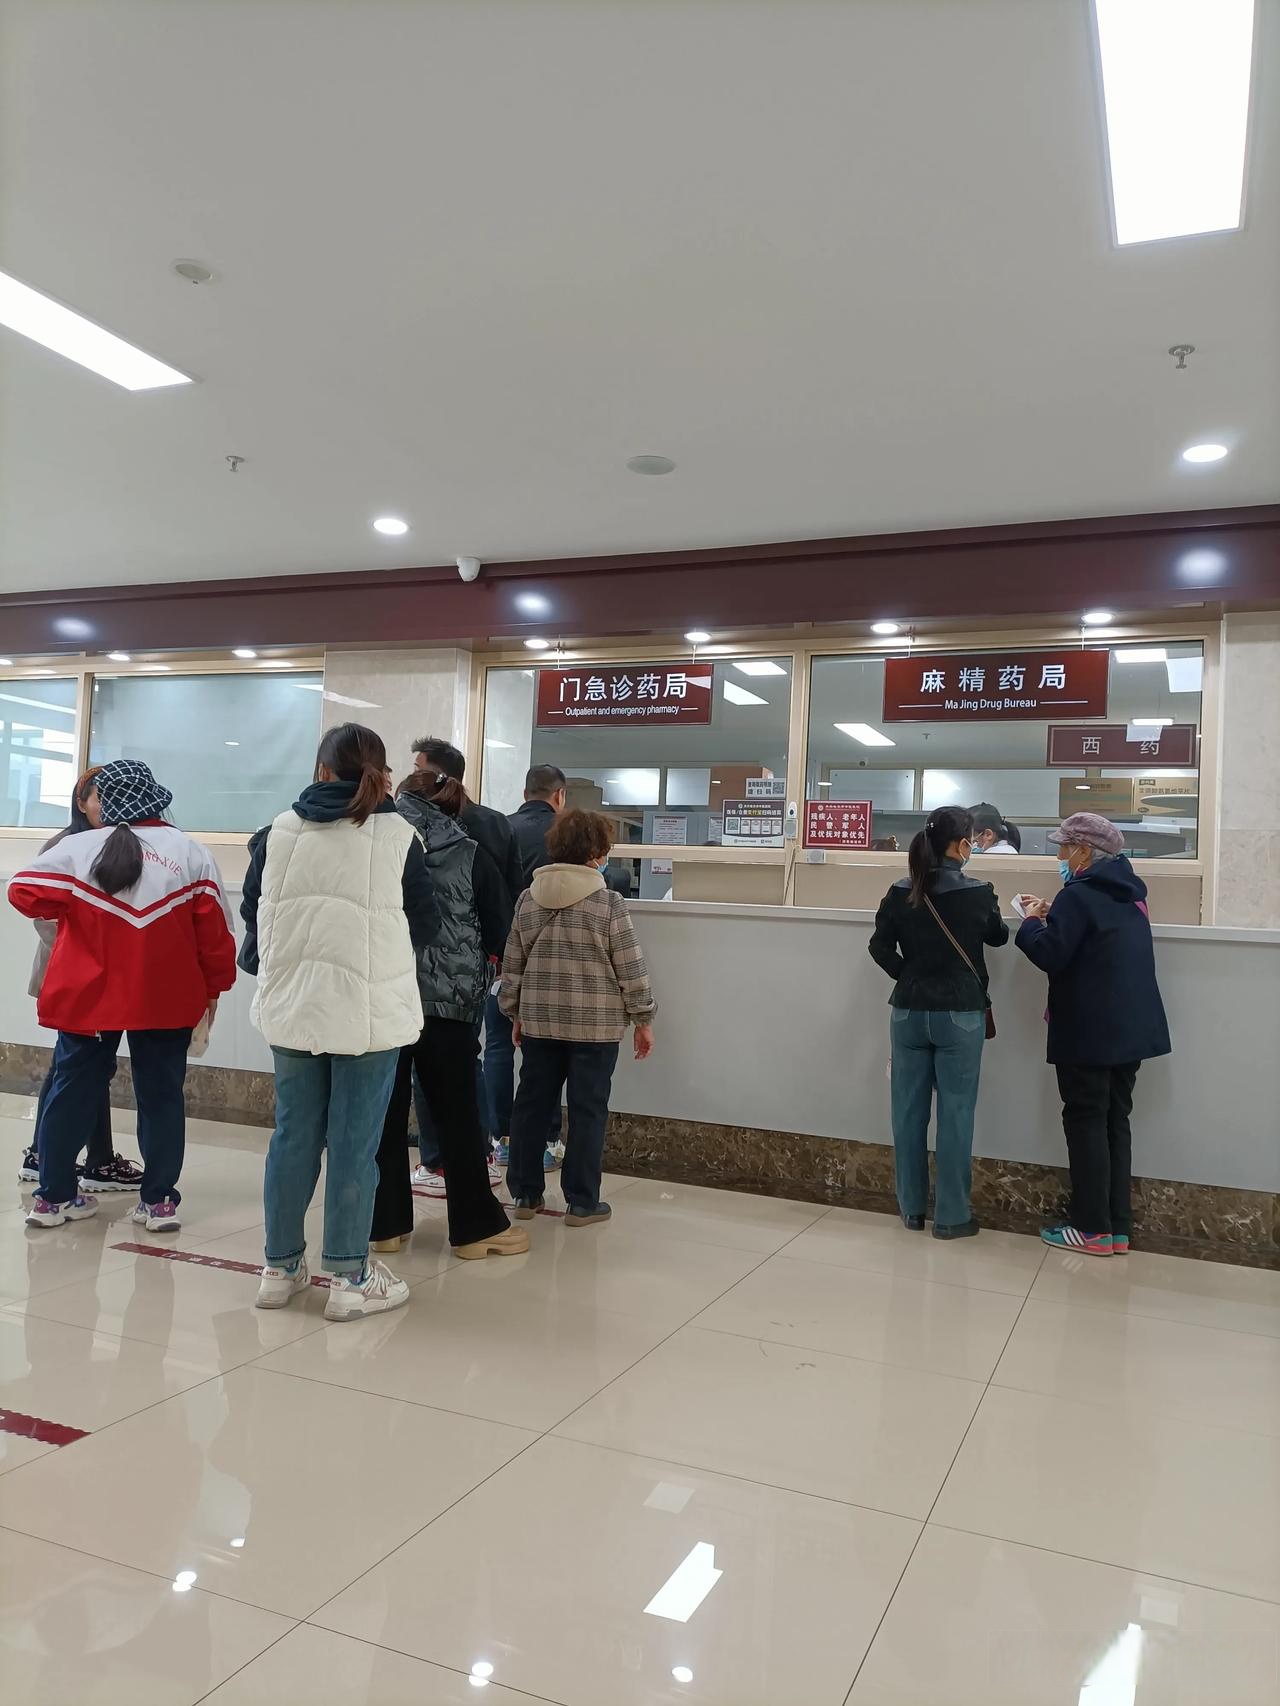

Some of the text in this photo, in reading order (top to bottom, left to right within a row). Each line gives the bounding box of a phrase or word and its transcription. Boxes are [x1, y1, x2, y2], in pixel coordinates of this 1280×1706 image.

[920, 664, 1066, 693] 麻精药局
[559, 673, 687, 702] 门急诊药局
[945, 698, 1037, 711] Ma Jing Drug Bureau
[565, 705, 680, 717] Outpatient and emergency pharmacy
[810, 812, 866, 822] 残疾人、老年人
[810, 830, 865, 839] 及优抚对象优先
